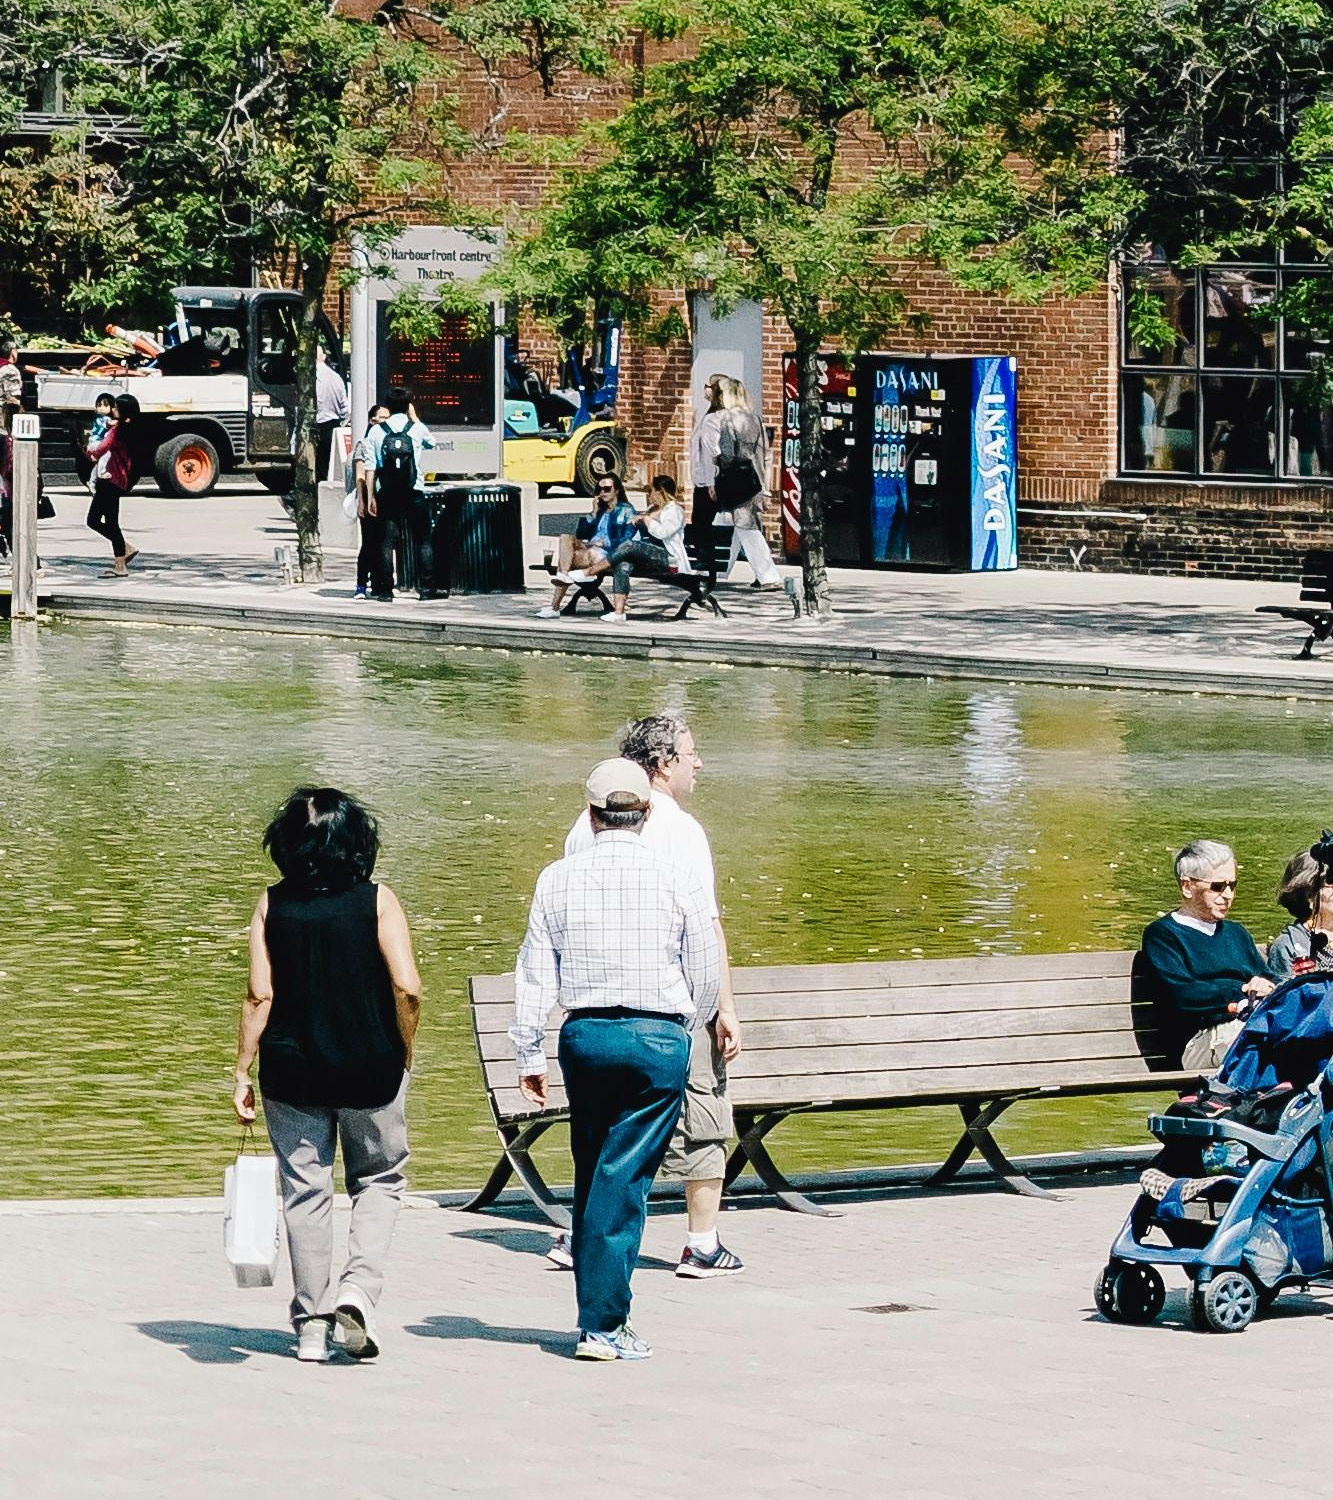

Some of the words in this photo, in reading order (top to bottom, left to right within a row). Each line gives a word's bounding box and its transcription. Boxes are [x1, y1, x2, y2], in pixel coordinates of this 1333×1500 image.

[391, 248, 457, 261] Harbourfront
[459, 250, 491, 262] centre
[876, 368, 939, 393] DASANI
[977, 394, 1011, 531] DASANI
